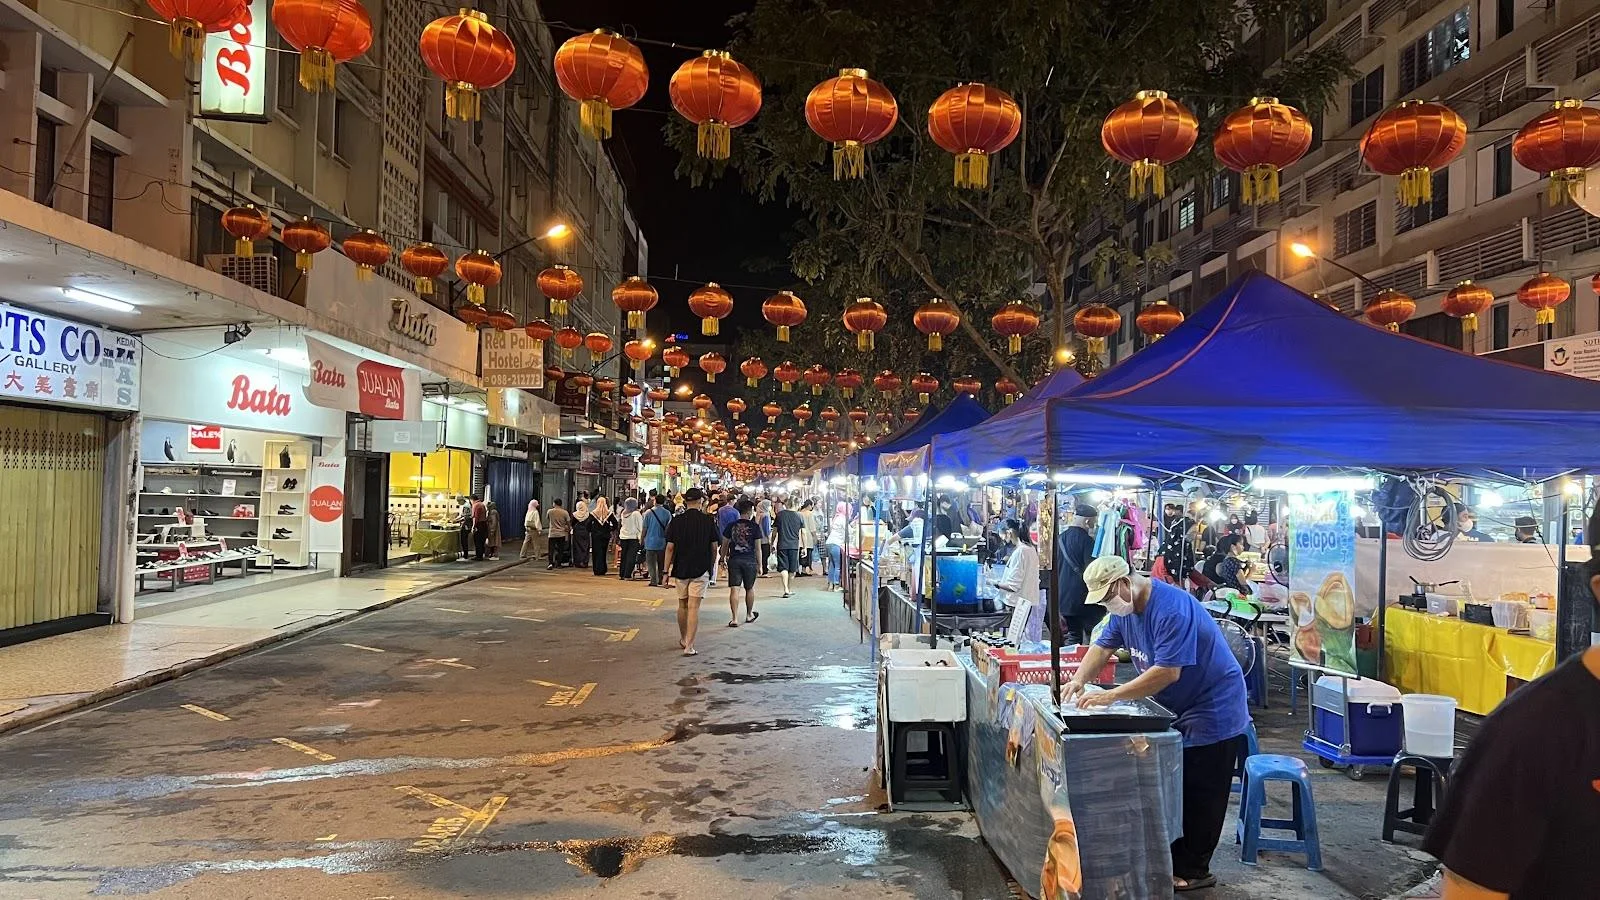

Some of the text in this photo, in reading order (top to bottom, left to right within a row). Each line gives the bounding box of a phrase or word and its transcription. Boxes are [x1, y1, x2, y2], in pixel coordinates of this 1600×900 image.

[389, 298, 438, 347] Bata
[0, 311, 101, 365] TS CO
[116, 336, 136, 348] KEDAI
[484, 332, 506, 350] Red
[14, 355, 77, 375] GALLERY
[488, 351, 523, 369] Hostel
[313, 360, 346, 389] Bata
[491, 374, 541, 386] 088-212773
[226, 374, 292, 417] Bata
[360, 371, 401, 400] JUALAN
[385, 398, 400, 411] Bata
[311, 499, 343, 507] JUALAN
[1296, 529, 1337, 553] kelapa
